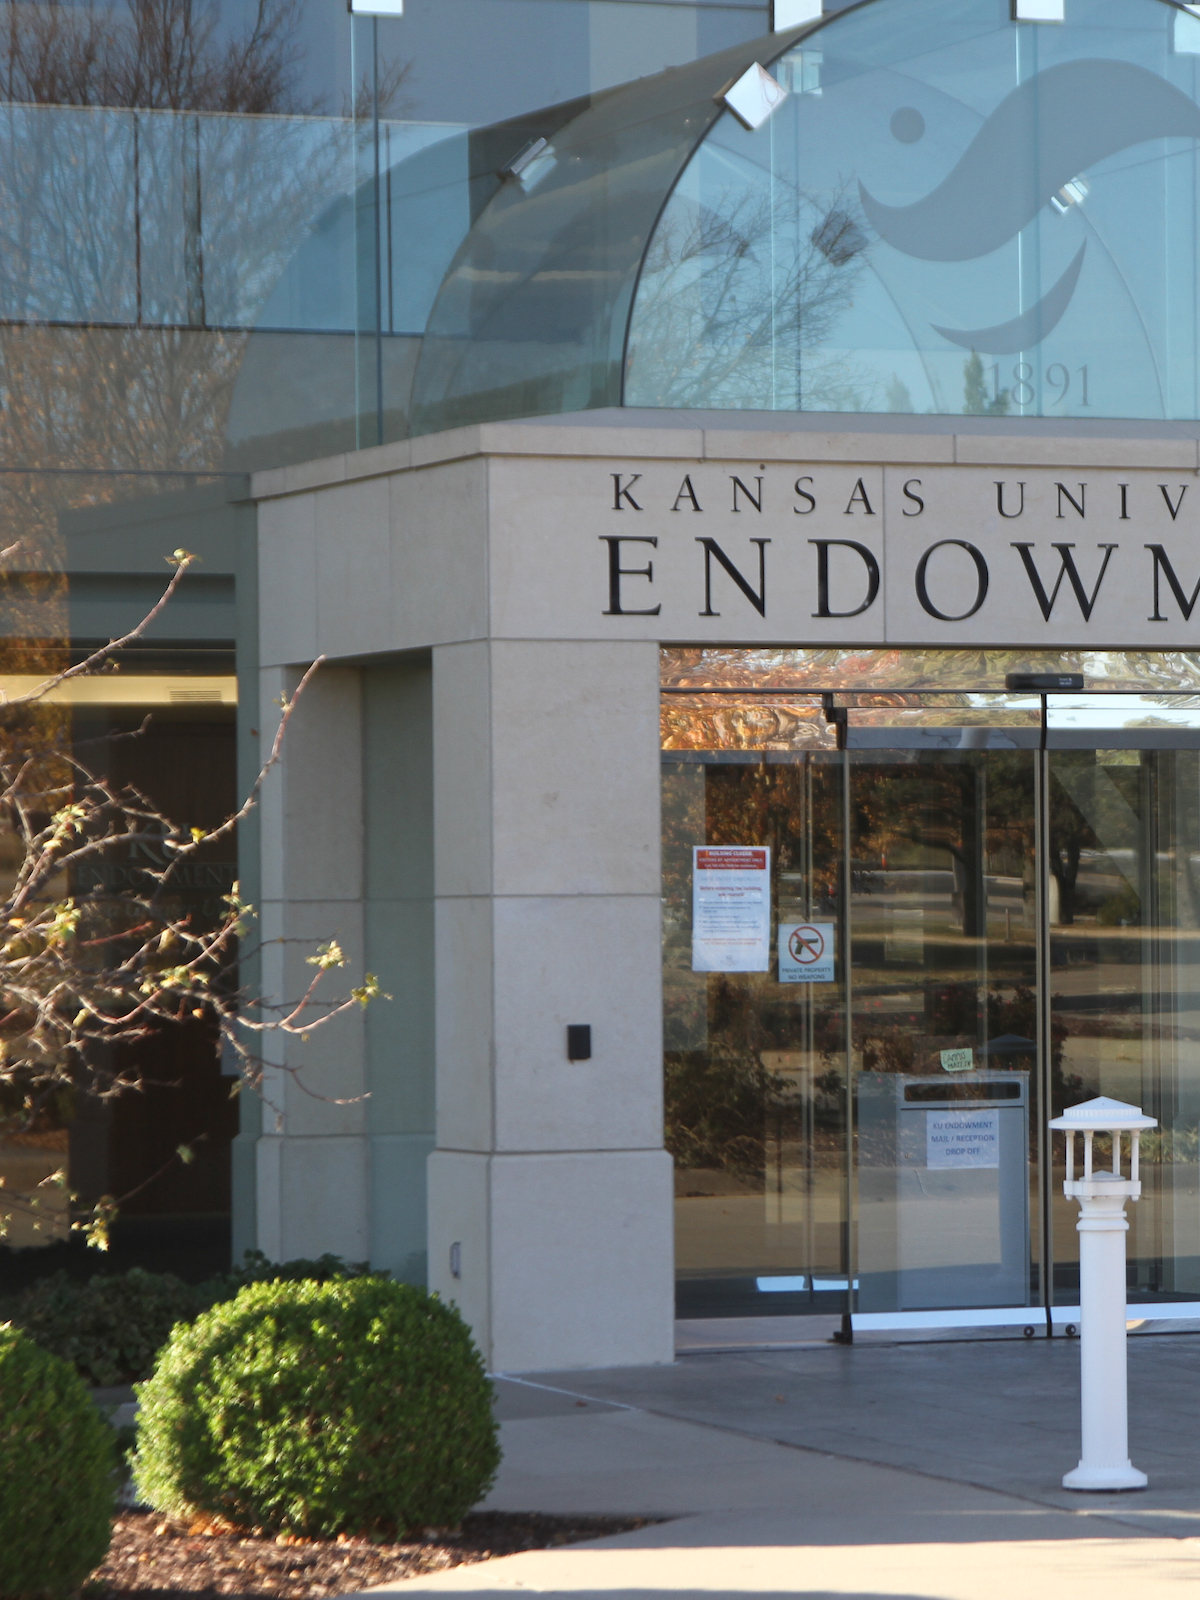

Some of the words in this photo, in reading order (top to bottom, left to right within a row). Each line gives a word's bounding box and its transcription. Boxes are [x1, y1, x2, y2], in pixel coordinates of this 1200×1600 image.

[986, 361, 1092, 407] 1891
[610, 473, 924, 517] KANSAS
[77, 865, 238, 886] ENDOMENT
[944, 1121, 993, 1129] ENDOWMENT
[931, 1135, 949, 1143] MAIL
[956, 1134, 995, 1142] RECEPTION
[945, 1148, 966, 1156] DROP
[967, 1147, 981, 1155] OFF
